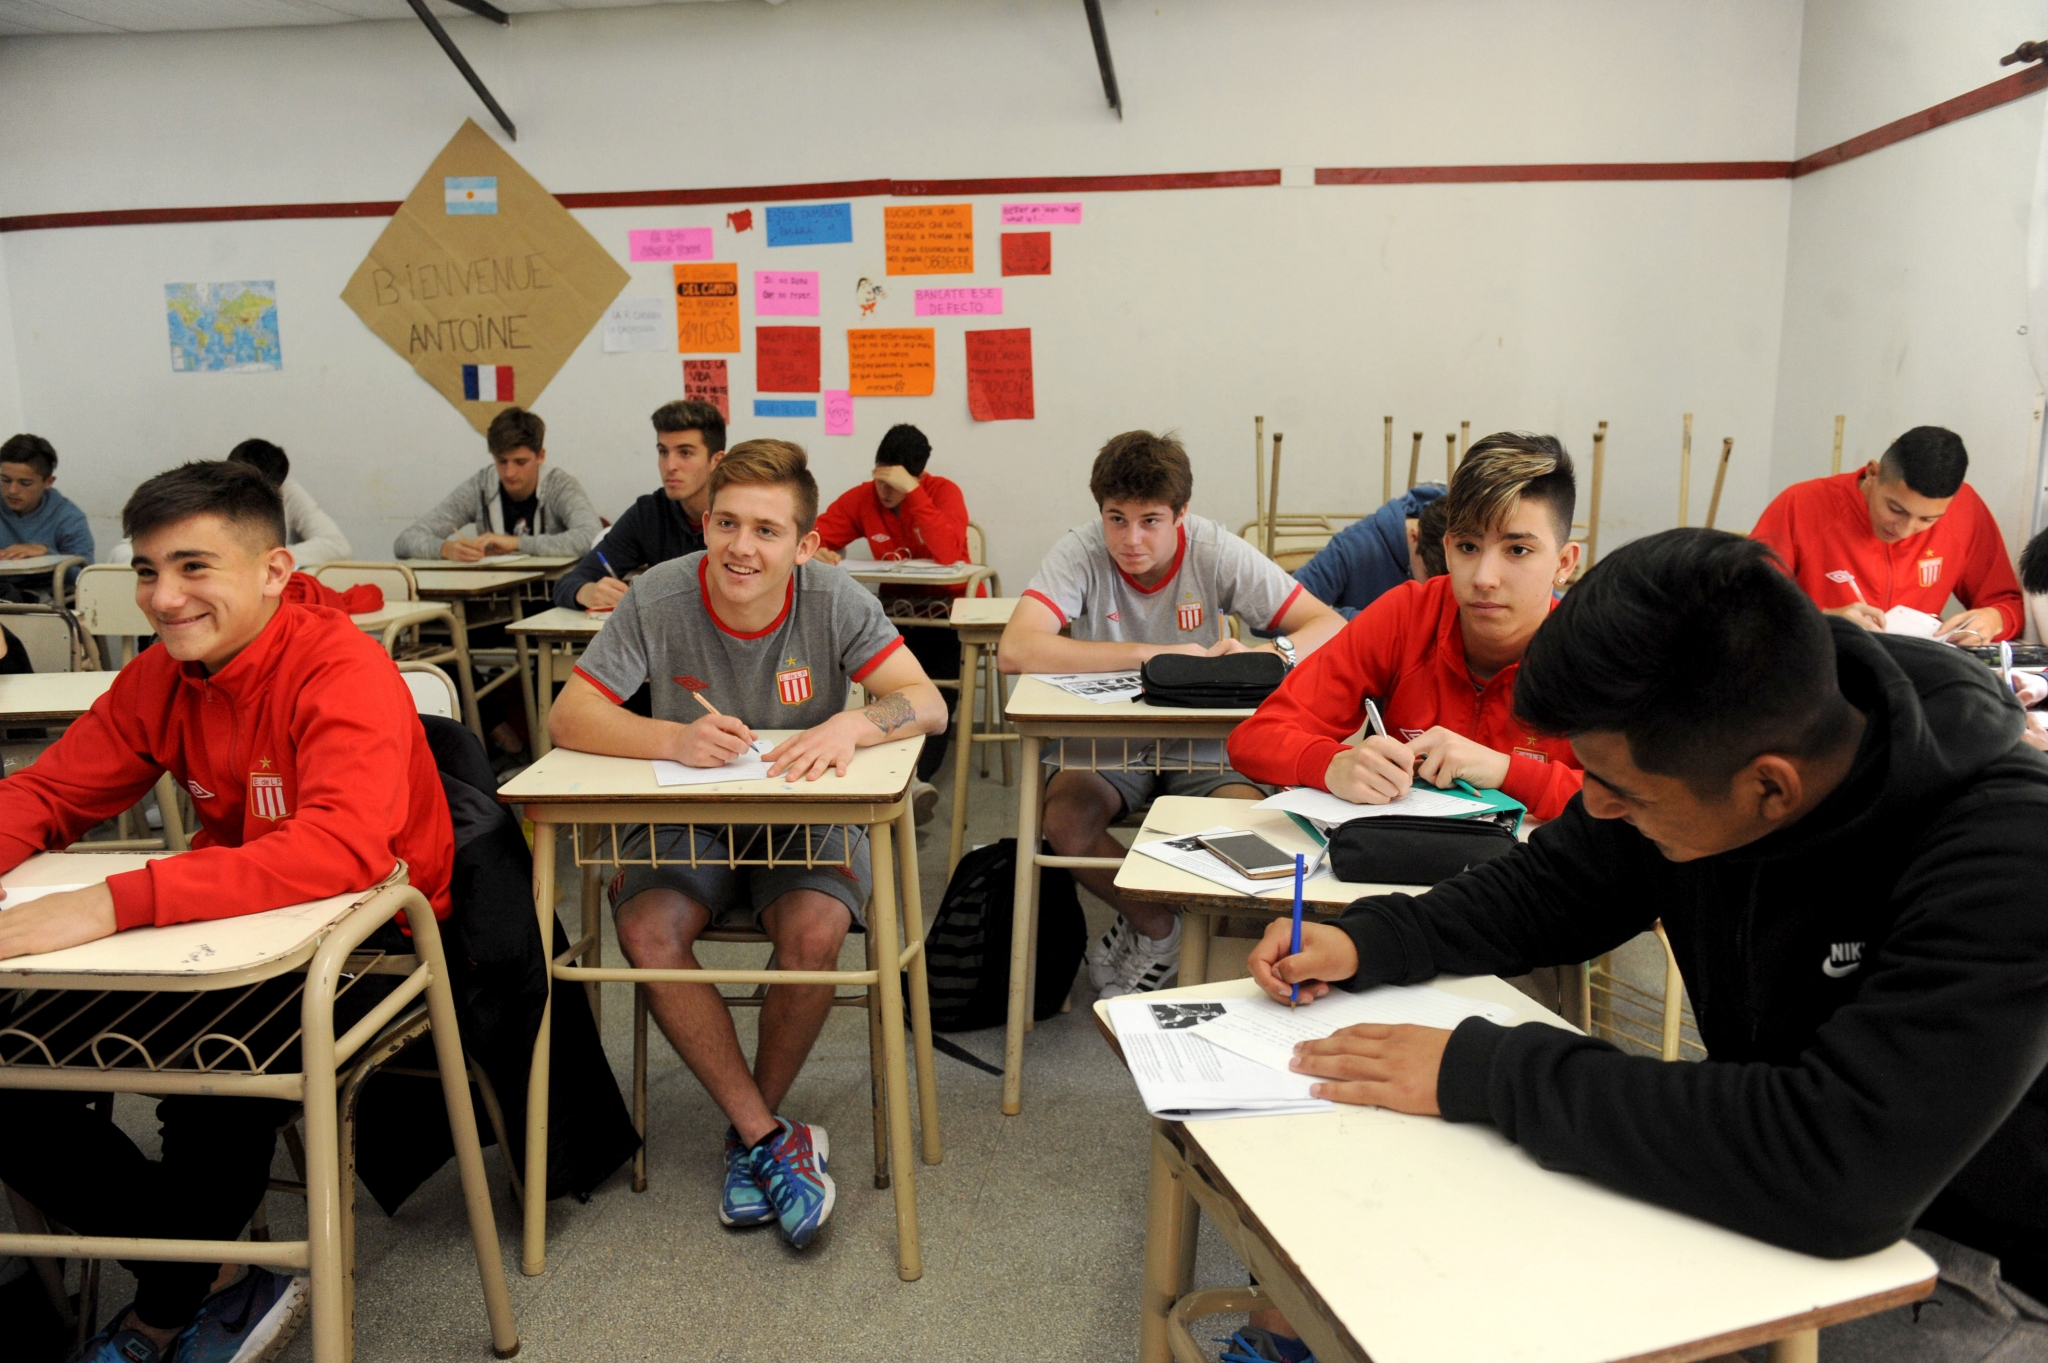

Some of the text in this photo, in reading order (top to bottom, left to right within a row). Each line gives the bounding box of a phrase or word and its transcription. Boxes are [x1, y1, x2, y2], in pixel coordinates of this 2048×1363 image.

[915, 288, 994, 302] BANCATE ESE
[929, 302, 984, 316] DEFECTO
[262, 778, 270, 786] de
[1830, 941, 1867, 962] NIK
